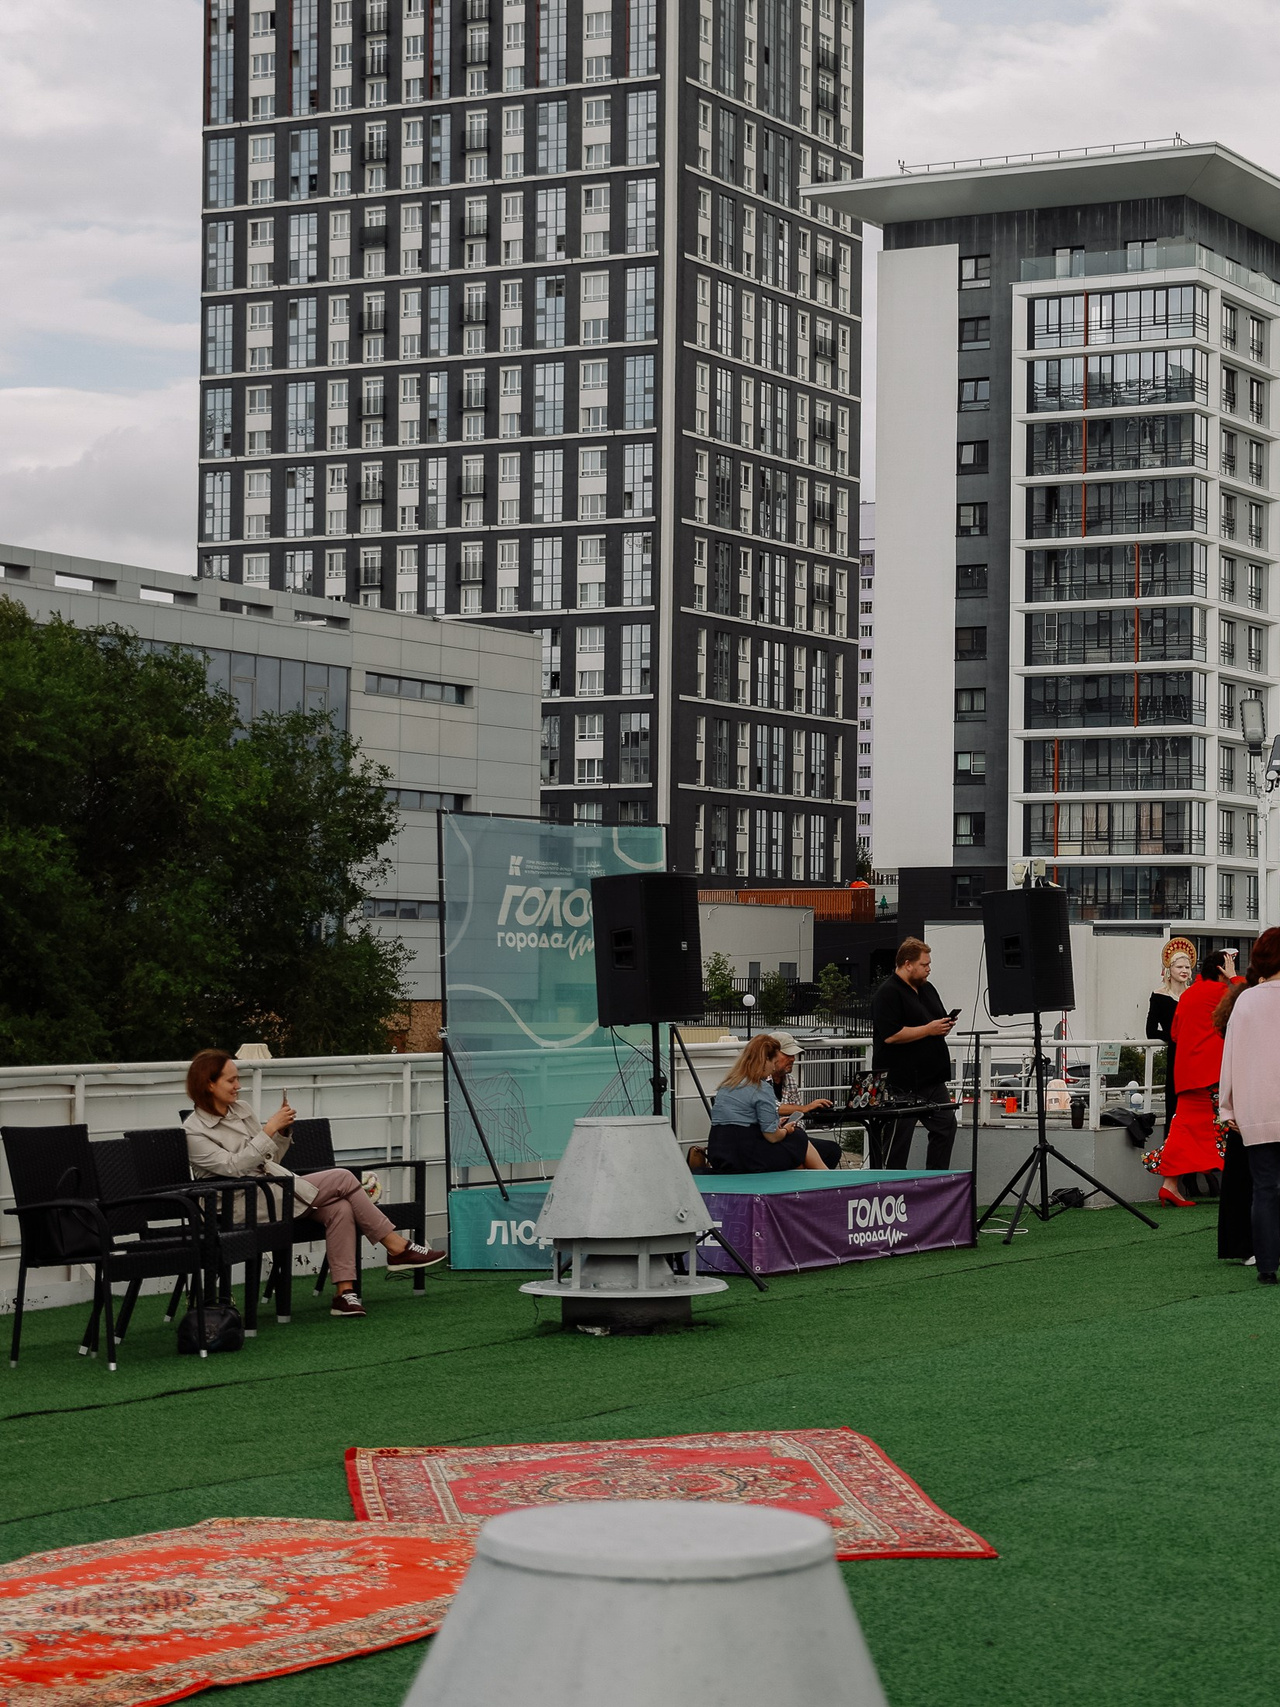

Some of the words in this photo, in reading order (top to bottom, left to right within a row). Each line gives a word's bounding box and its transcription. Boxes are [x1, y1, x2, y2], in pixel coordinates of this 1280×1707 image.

[497, 885, 593, 927] ГОЛО
[848, 1194, 908, 1229] ГОЛОС
[486, 1220, 554, 1250] ЛЮ
[848, 1229, 888, 1247] города
